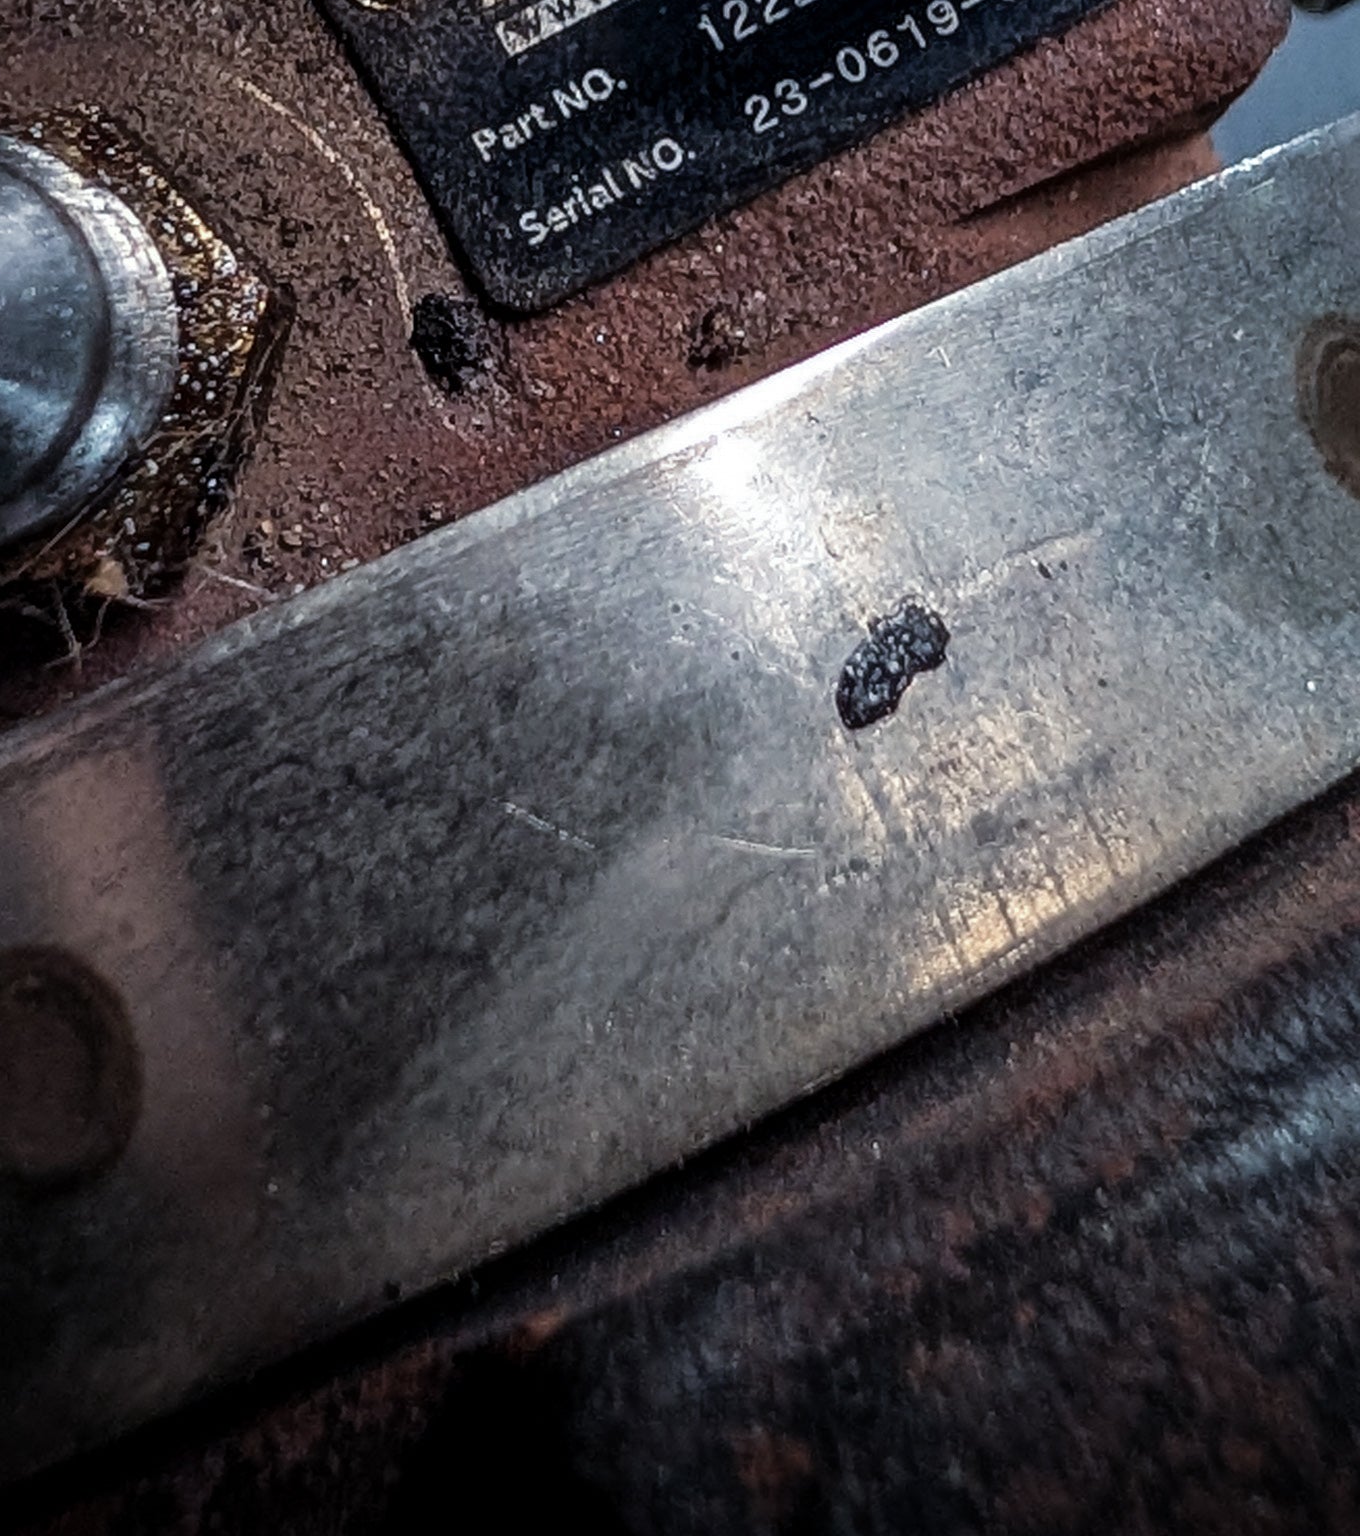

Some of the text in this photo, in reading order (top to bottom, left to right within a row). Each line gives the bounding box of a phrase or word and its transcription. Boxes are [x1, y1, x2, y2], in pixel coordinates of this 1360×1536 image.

[471, 101, 557, 162] Part
[552, 67, 628, 119] NO.
[518, 167, 625, 247] Serial
[622, 136, 697, 190] NO.
